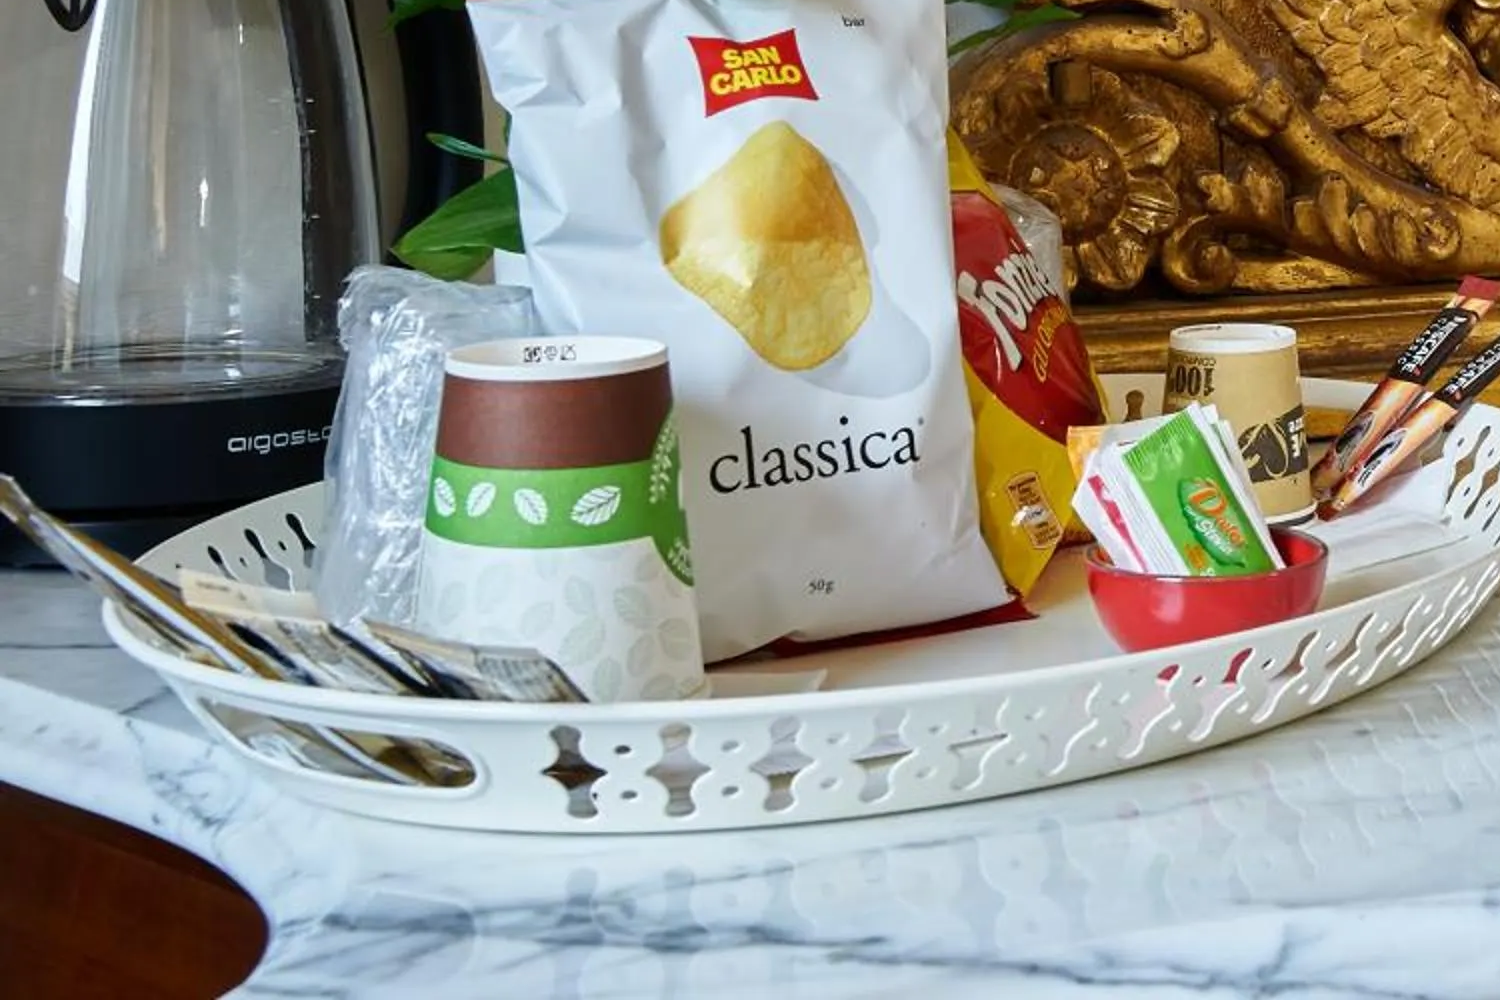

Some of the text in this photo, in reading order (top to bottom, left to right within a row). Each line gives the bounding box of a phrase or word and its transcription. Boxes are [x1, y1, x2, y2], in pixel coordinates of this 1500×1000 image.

[722, 46, 781, 69] SAN
[710, 64, 801, 96] CARLO
[709, 416, 921, 493] classica
